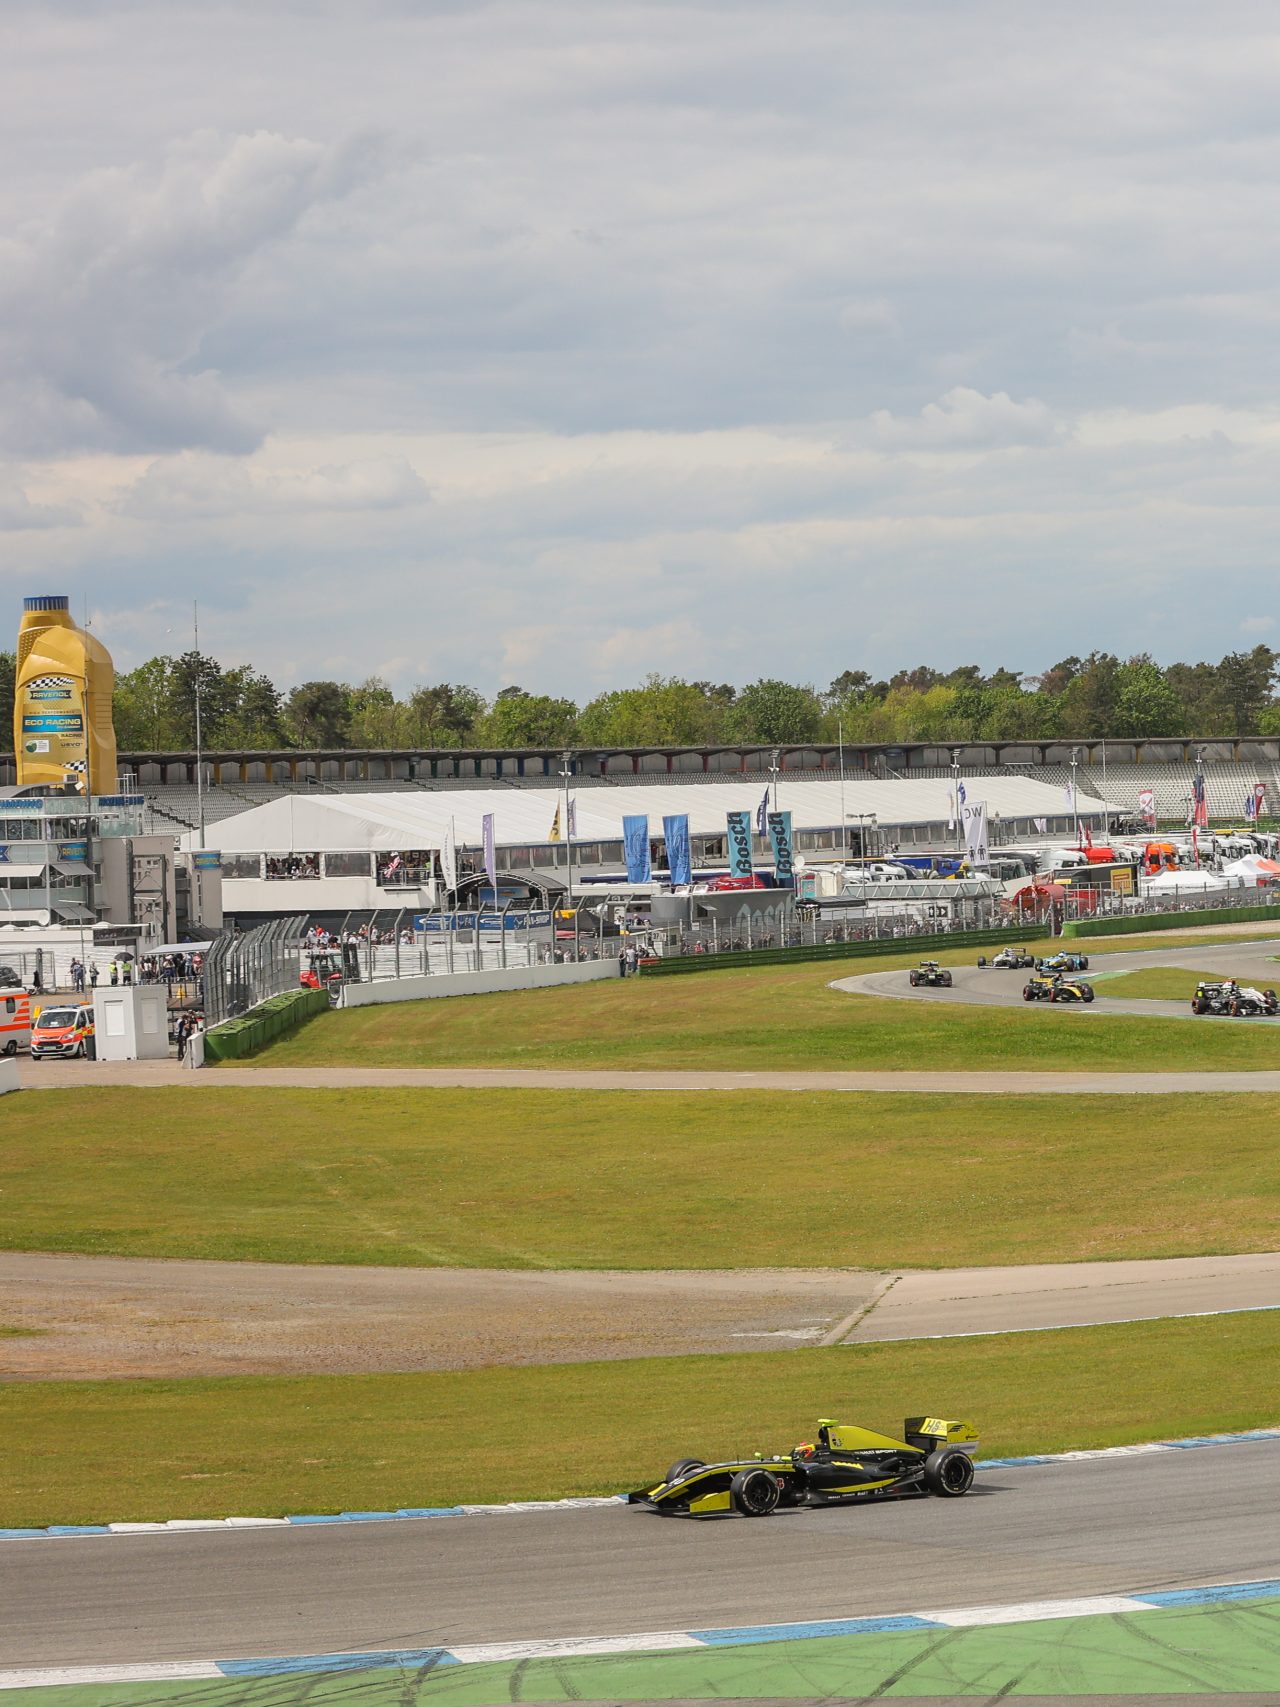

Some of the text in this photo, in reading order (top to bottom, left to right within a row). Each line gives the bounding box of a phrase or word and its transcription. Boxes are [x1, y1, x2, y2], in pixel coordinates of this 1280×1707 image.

[46, 718, 81, 726] RACING
[727, 812, 753, 876] Bosch
[768, 812, 794, 876] Bosch
